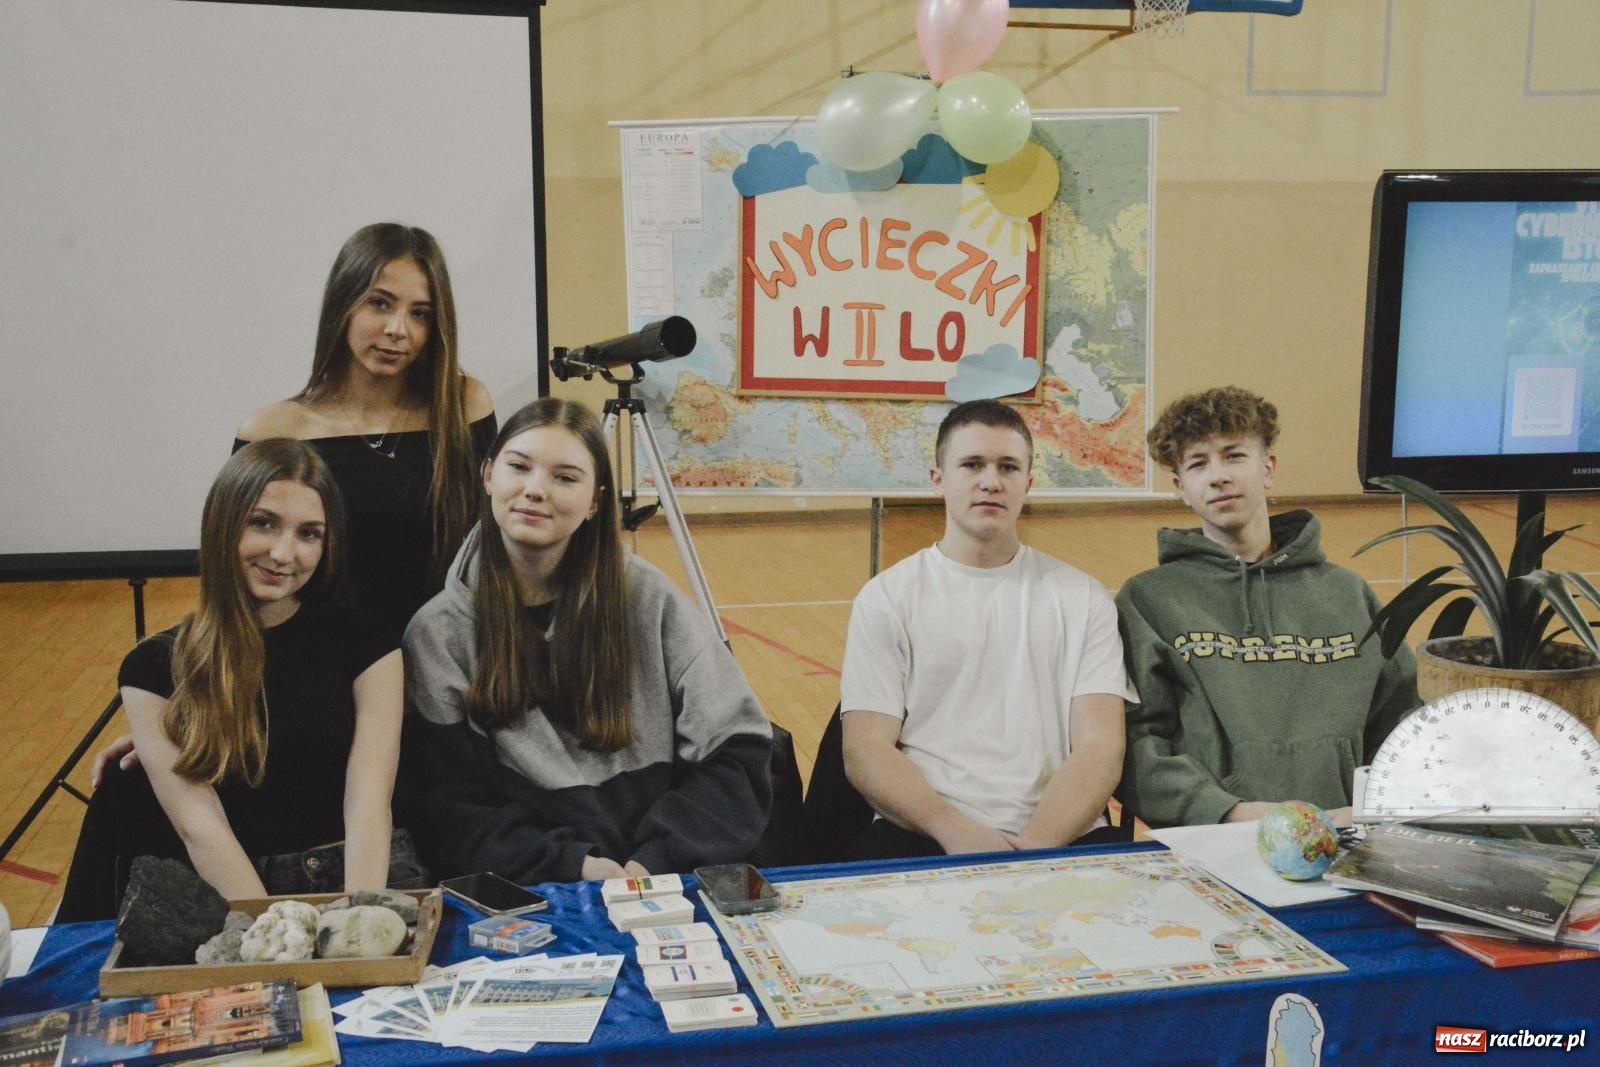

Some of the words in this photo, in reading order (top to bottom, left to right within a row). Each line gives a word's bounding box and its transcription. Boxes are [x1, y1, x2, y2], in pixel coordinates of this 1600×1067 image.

[640, 133, 689, 143] EUROPA
[746, 217, 1032, 327] WYCIECZKI
[793, 306, 830, 358] W
[842, 302, 886, 367] II
[899, 311, 966, 362] LO
[1501, 701, 1510, 709] 10
[1519, 704, 1532, 714] 20
[1537, 712, 1550, 722] 30
[1553, 721, 1566, 733] 40
[1568, 734, 1579, 746] 50
[1580, 749, 1592, 761] 60
